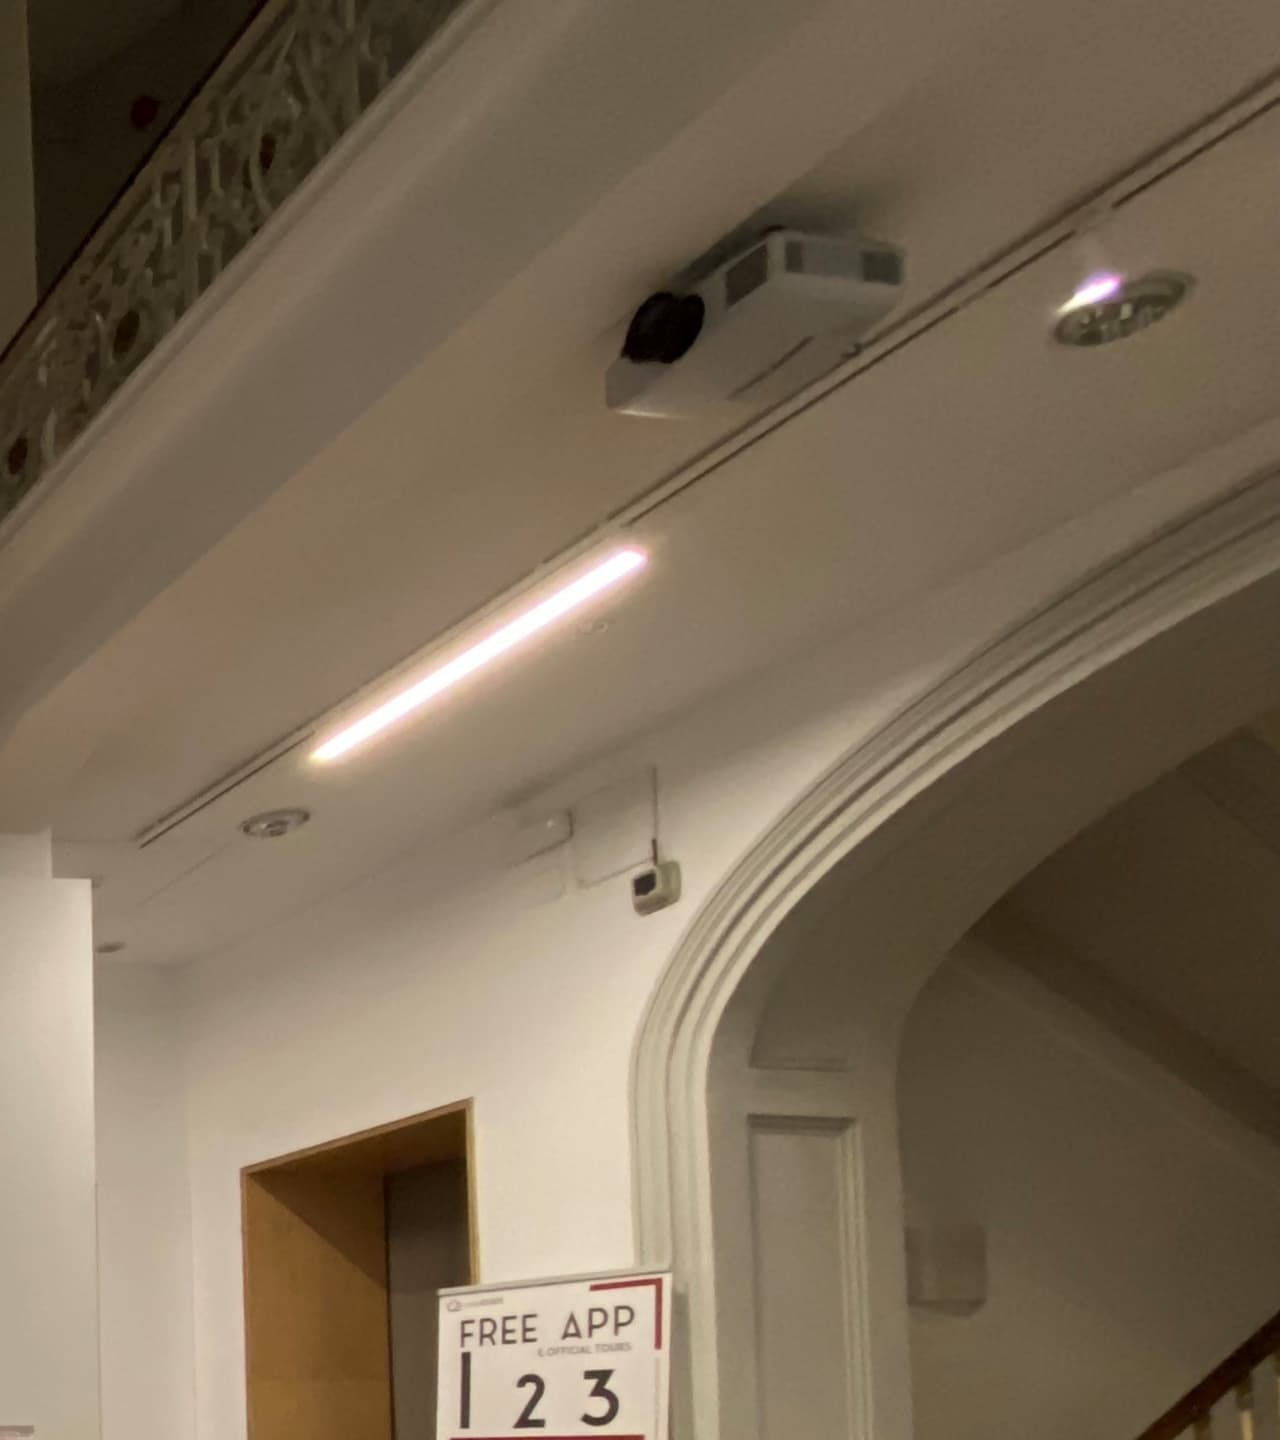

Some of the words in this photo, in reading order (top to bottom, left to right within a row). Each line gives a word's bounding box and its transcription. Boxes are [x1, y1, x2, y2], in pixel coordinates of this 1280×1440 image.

[460, 1313, 539, 1348] FREE
[561, 1305, 636, 1341] APP
[512, 1373, 546, 1429] 2
[580, 1369, 620, 1427] 3
